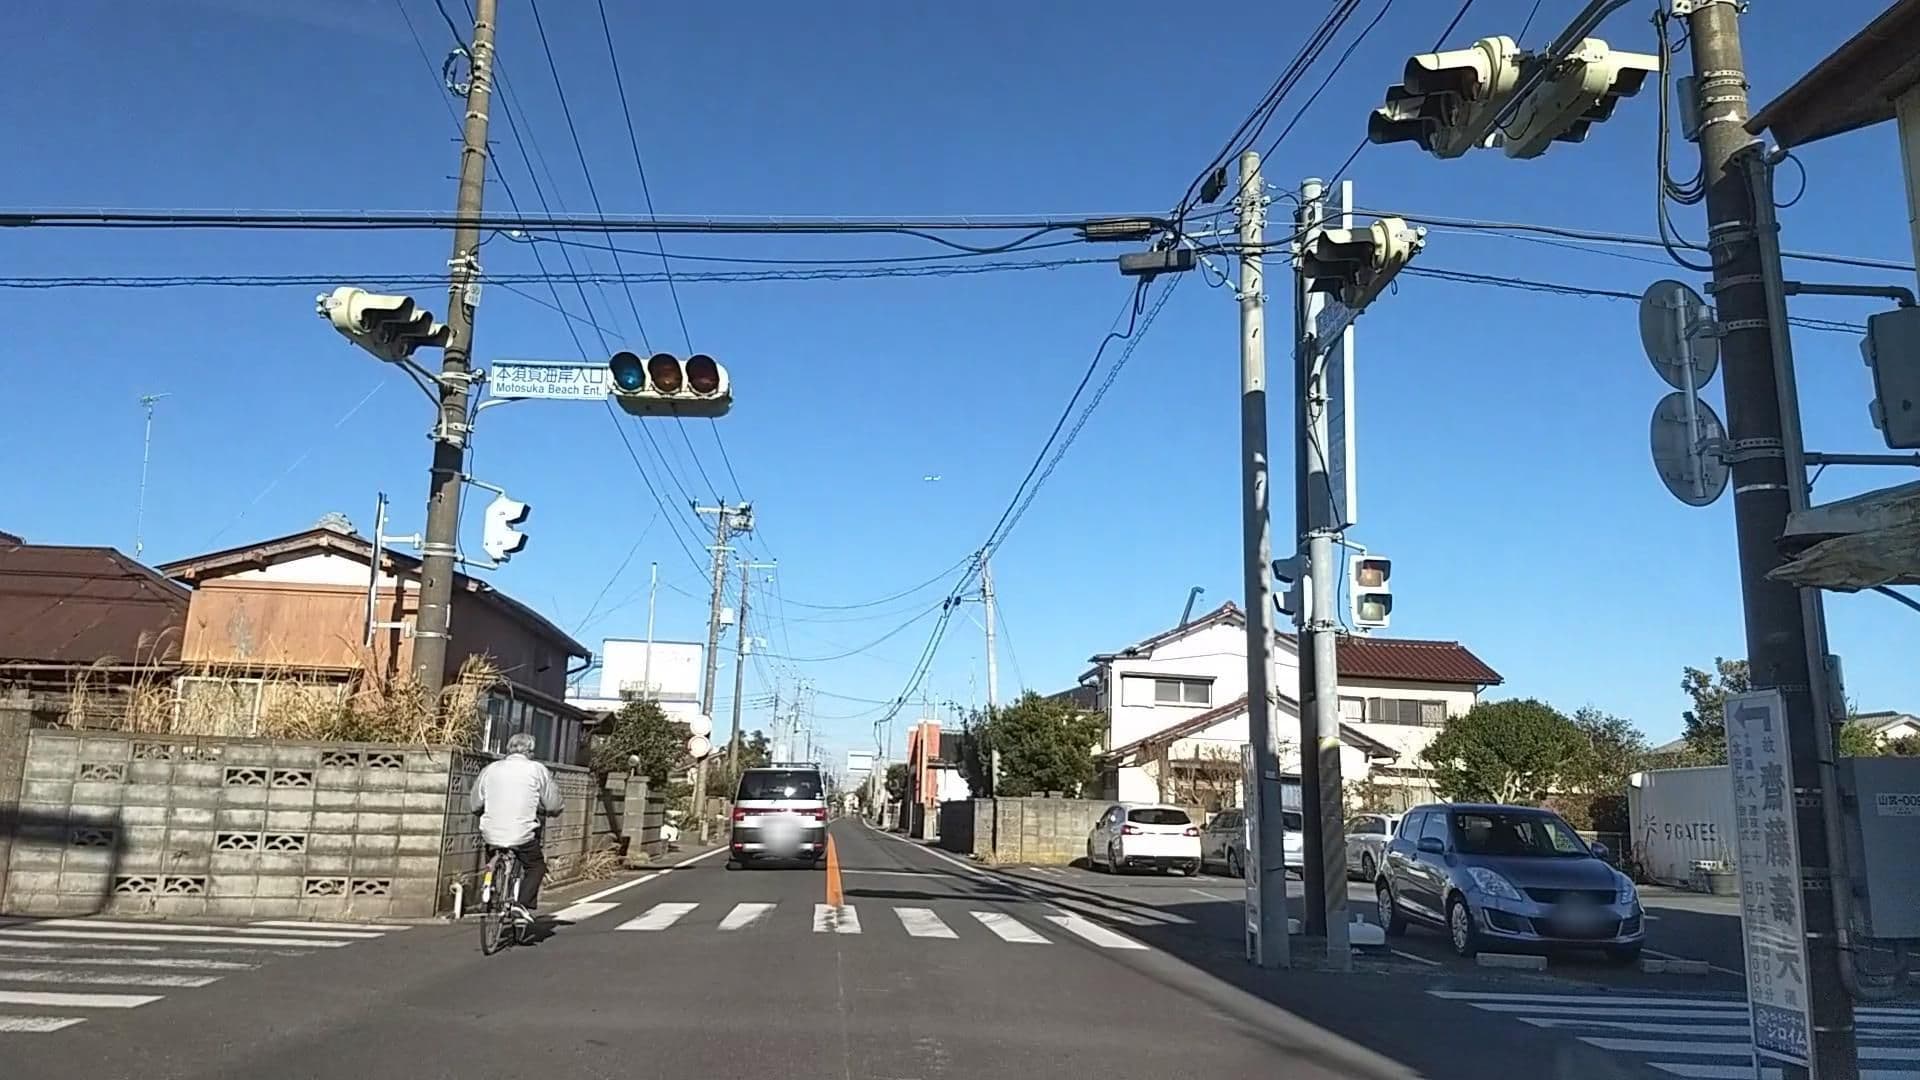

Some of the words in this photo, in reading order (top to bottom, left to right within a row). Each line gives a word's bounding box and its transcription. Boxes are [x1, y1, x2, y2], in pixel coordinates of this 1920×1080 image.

[497, 366, 603, 384] 本須賀海岸入口
[496, 383, 545, 394] Motosuka
[548, 384, 580, 396] Beach
[583, 385, 602, 397] Ent.
